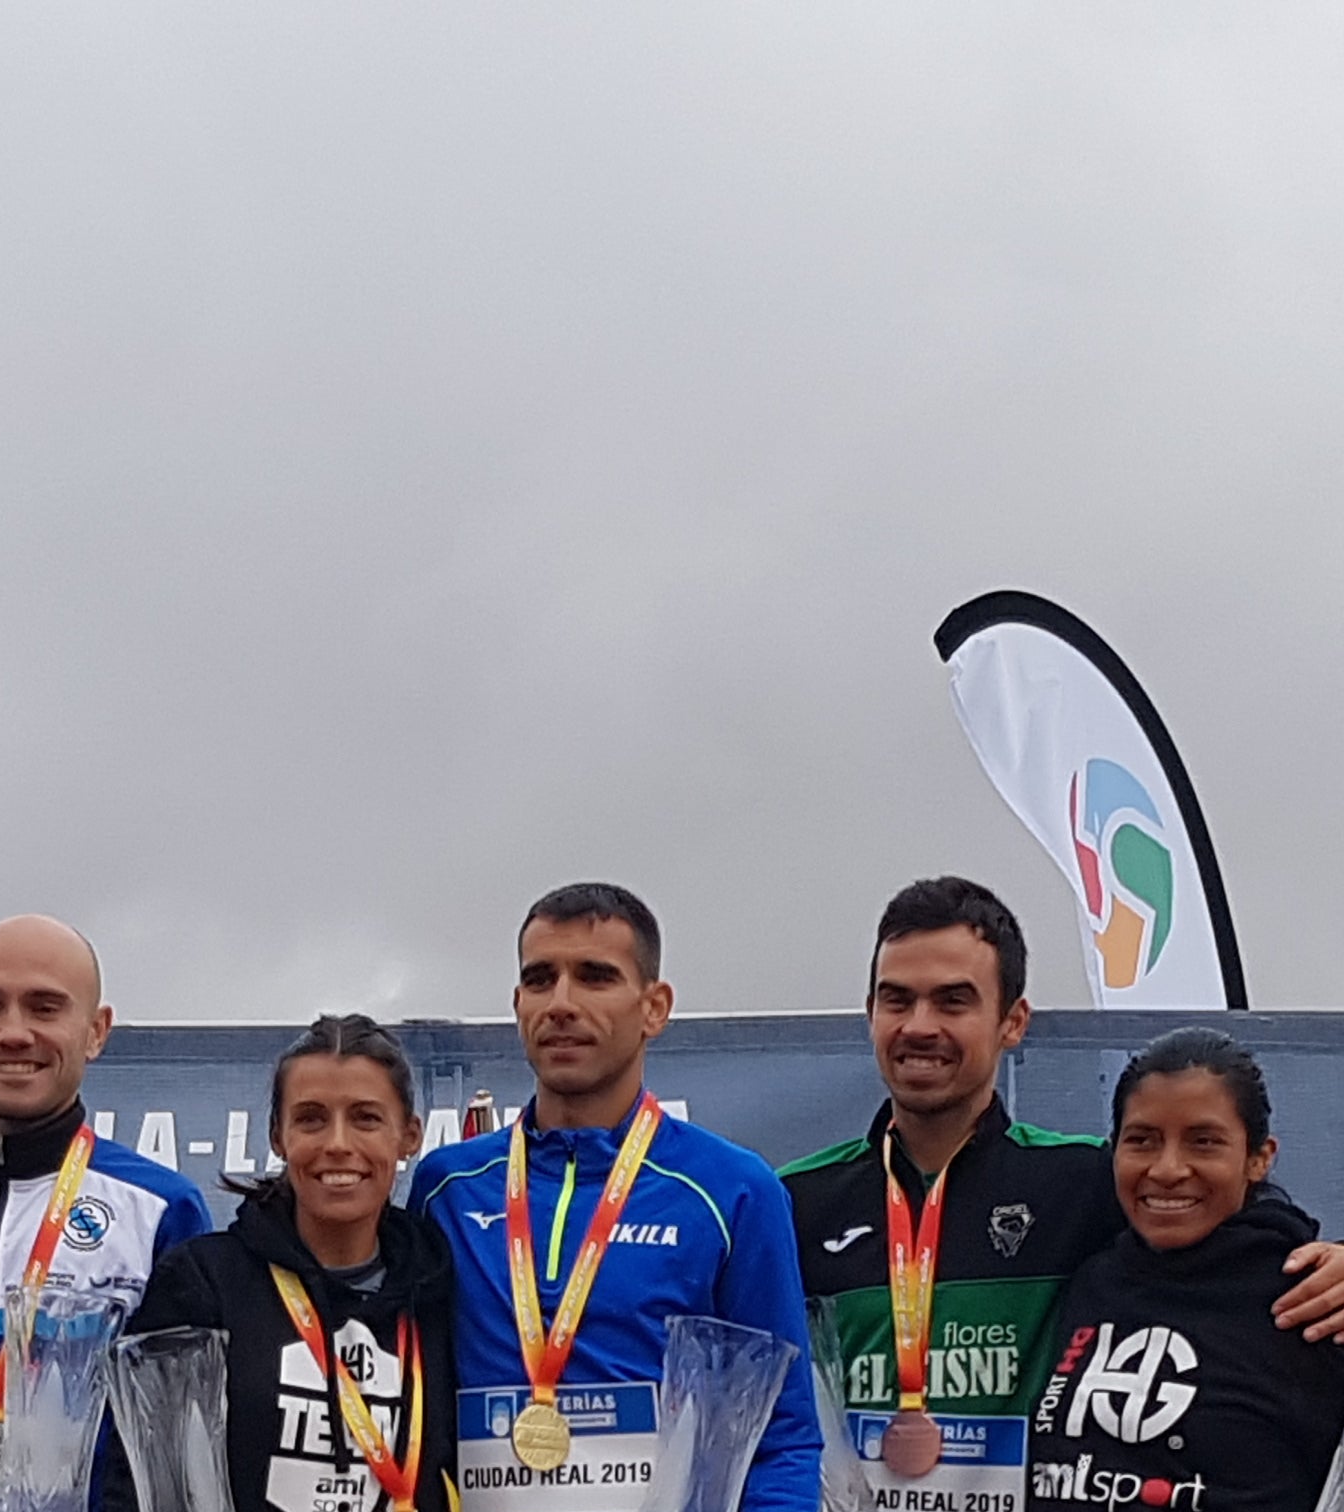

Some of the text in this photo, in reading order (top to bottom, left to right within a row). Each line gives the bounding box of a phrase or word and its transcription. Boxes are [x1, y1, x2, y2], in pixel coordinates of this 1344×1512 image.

[607, 1223, 679, 1247] IKILA
[943, 1321, 1018, 1347] flores
[848, 1346, 1020, 1403] EL ISNE
[1034, 1373, 1069, 1434] SPORT
[464, 1461, 652, 1490] CIUDAD REAL 2019
